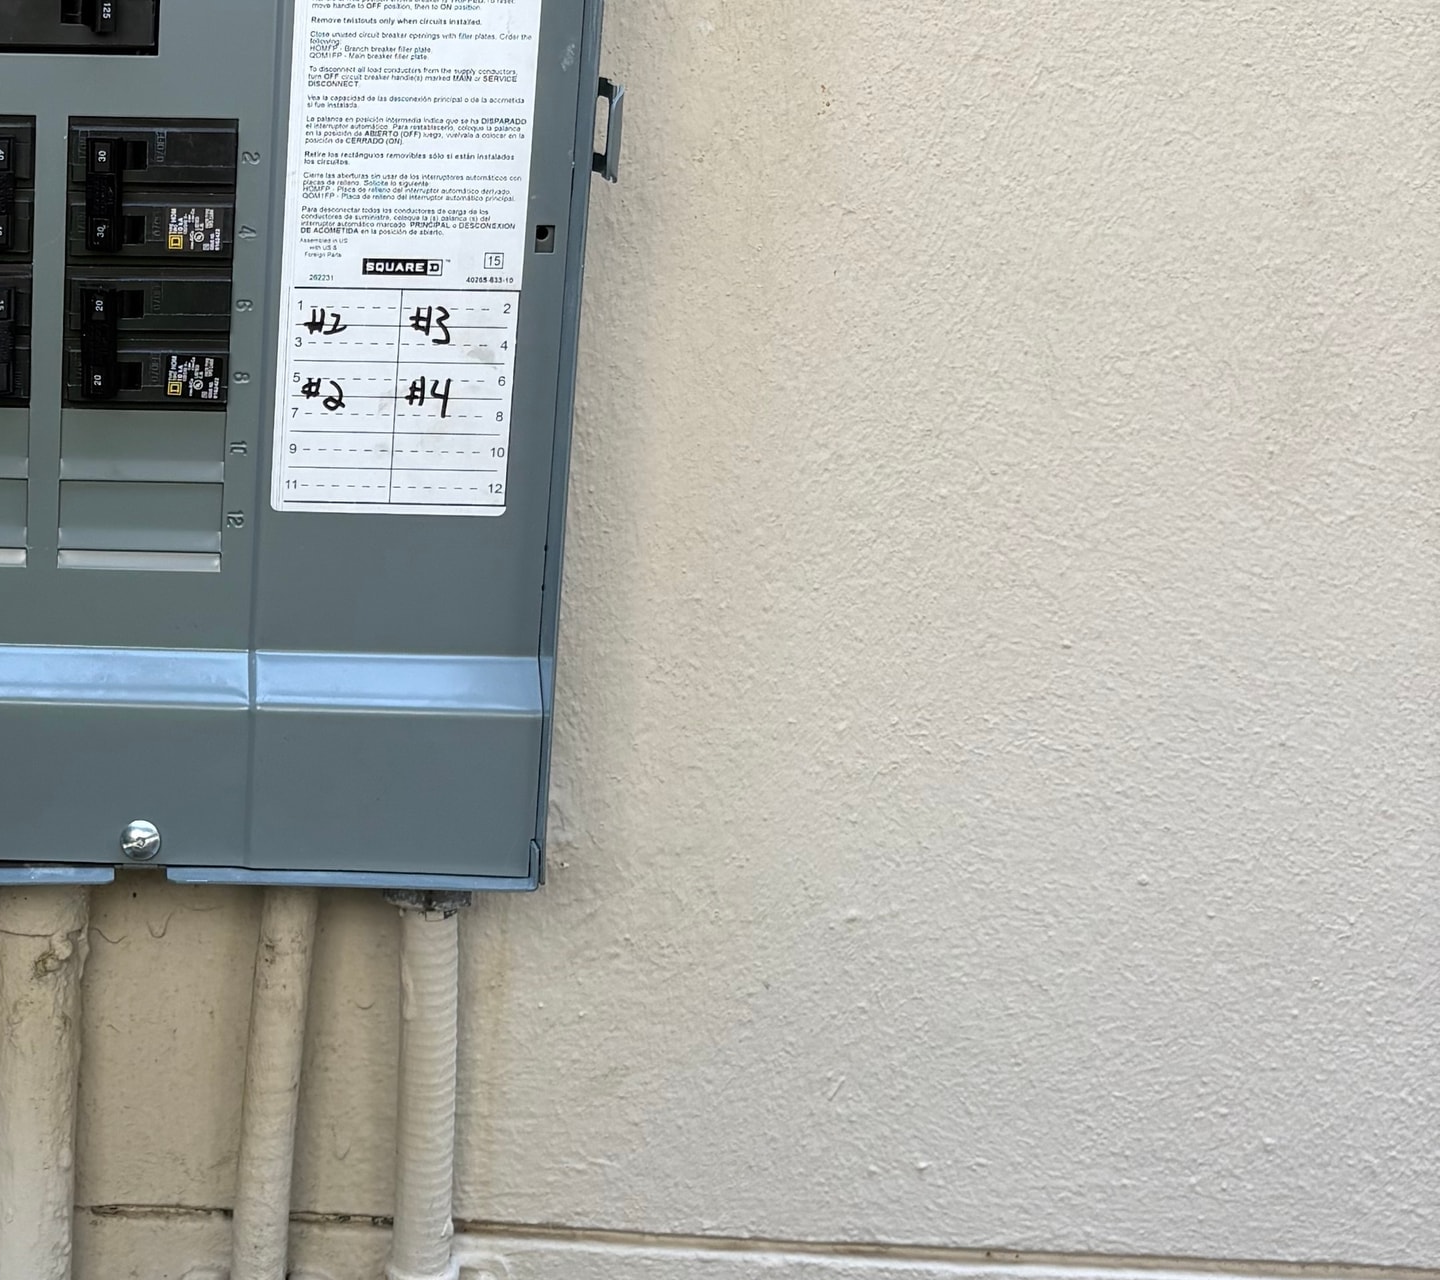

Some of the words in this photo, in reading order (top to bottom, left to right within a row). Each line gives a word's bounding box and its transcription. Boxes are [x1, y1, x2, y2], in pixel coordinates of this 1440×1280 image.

[102, 2, 111, 19] 125
[379, 17, 395, 26] only
[98, 150, 106, 163] 30
[242, 152, 260, 166] 2
[97, 225, 106, 238] 30
[238, 226, 257, 240] 4
[488, 255, 501, 266] 15
[366, 262, 425, 273] SQUARE
[429, 263, 440, 273] D
[96, 300, 103, 312] 20
[236, 300, 253, 312] 6
[297, 300, 303, 310] 1
[504, 304, 511, 314] 2
[410, 306, 450, 344] #3
[295, 338, 302, 347] 3
[500, 341, 508, 350] 4
[94, 375, 102, 386] 20
[233, 372, 250, 384] 8
[292, 373, 301, 382] 5
[498, 377, 506, 386] 6
[301, 378, 345, 410] #2
[405, 376, 451, 418] #4
[291, 408, 299, 418] 7
[495, 412, 503, 422] 8
[230, 441, 247, 456] 10
[289, 444, 297, 454] 9
[491, 448, 505, 458] 10
[285, 480, 297, 490] 11
[488, 484, 502, 494] 12
[227, 510, 244, 528] 12
